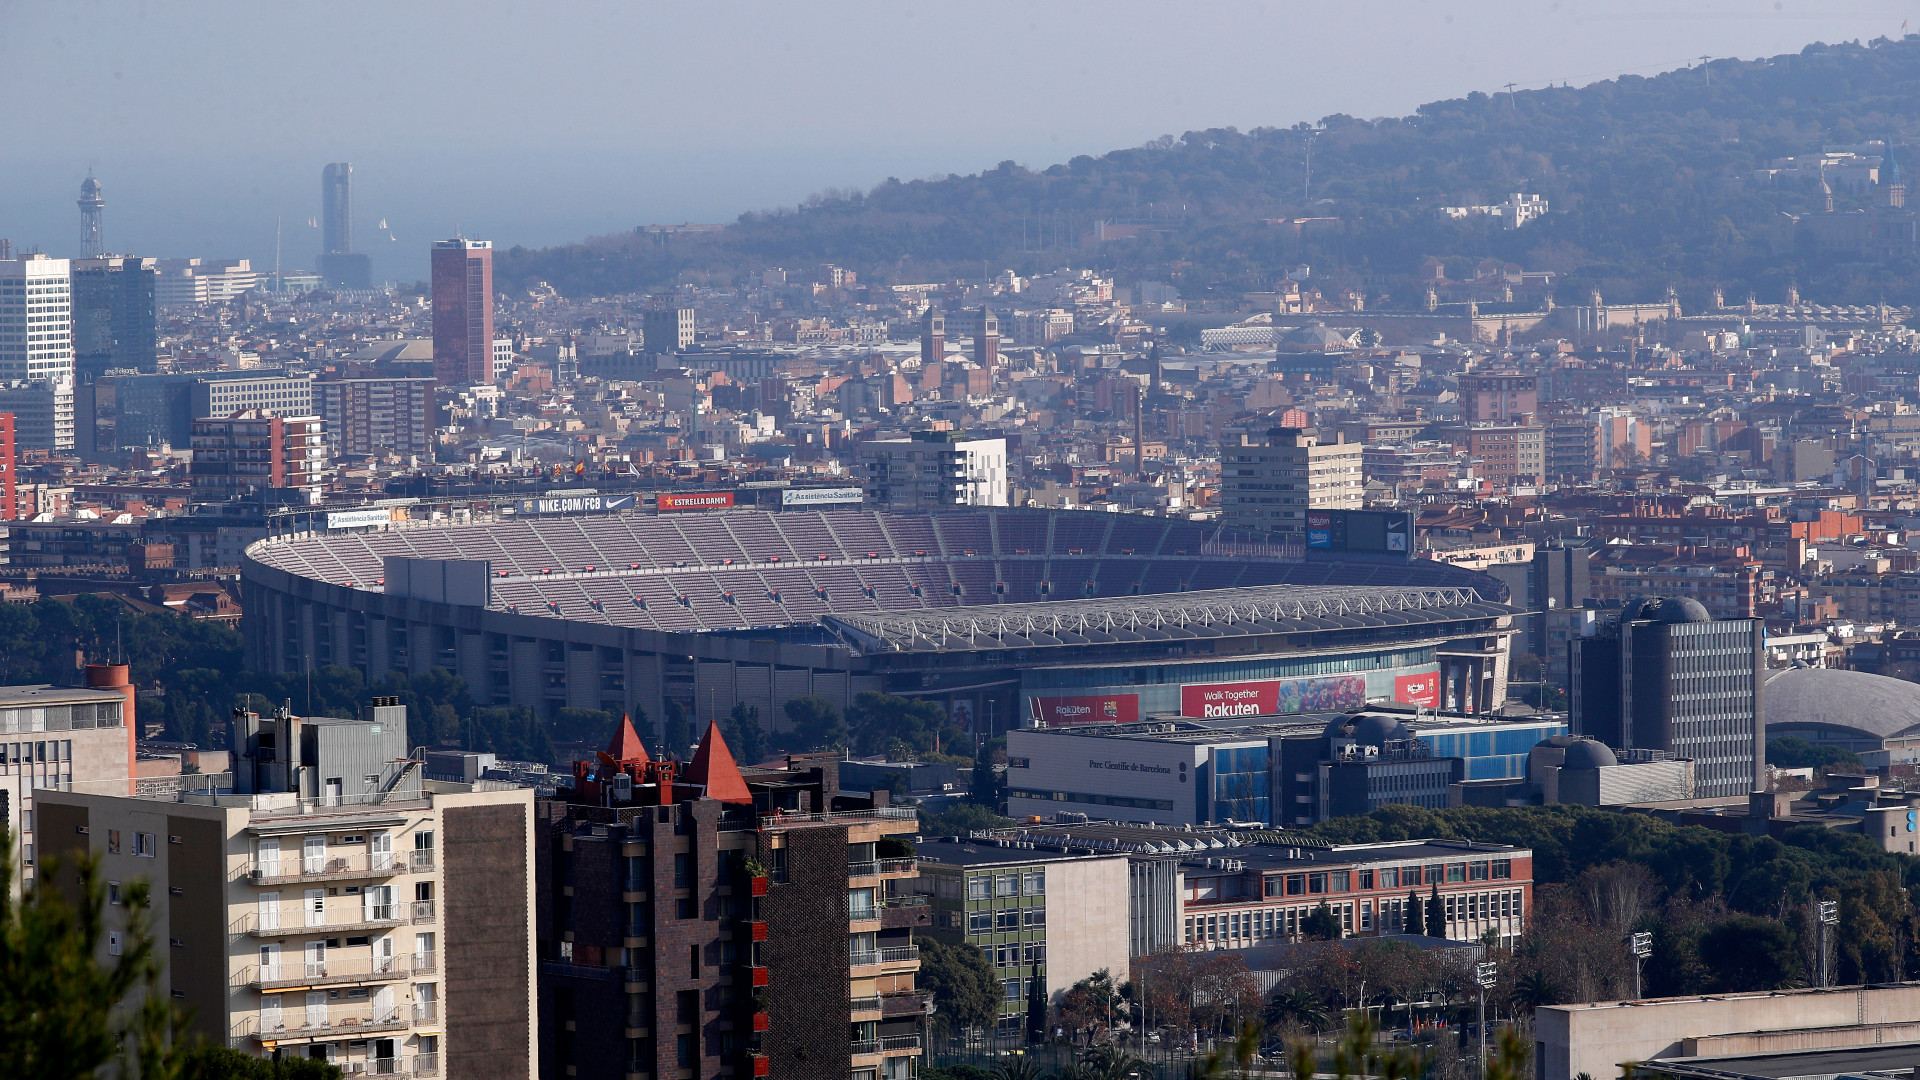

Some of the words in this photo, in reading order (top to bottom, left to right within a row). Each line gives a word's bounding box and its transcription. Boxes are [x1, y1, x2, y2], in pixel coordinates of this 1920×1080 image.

[539, 498, 600, 512] NIKE.COM/FCB
[674, 498, 705, 506] ESTRELLA
[706, 497, 726, 505] DAMM
[1309, 517, 1329, 525] Rakuten
[1310, 532, 1327, 540] beko
[1204, 691, 1224, 701] Walk
[1225, 689, 1259, 701] Together
[1056, 705, 1090, 714] Rakuten
[1204, 702, 1259, 717] Rakuten
[1089, 760, 1103, 769] Parc
[1130, 763, 1139, 771] de
[1140, 764, 1171, 774] Barcelona
